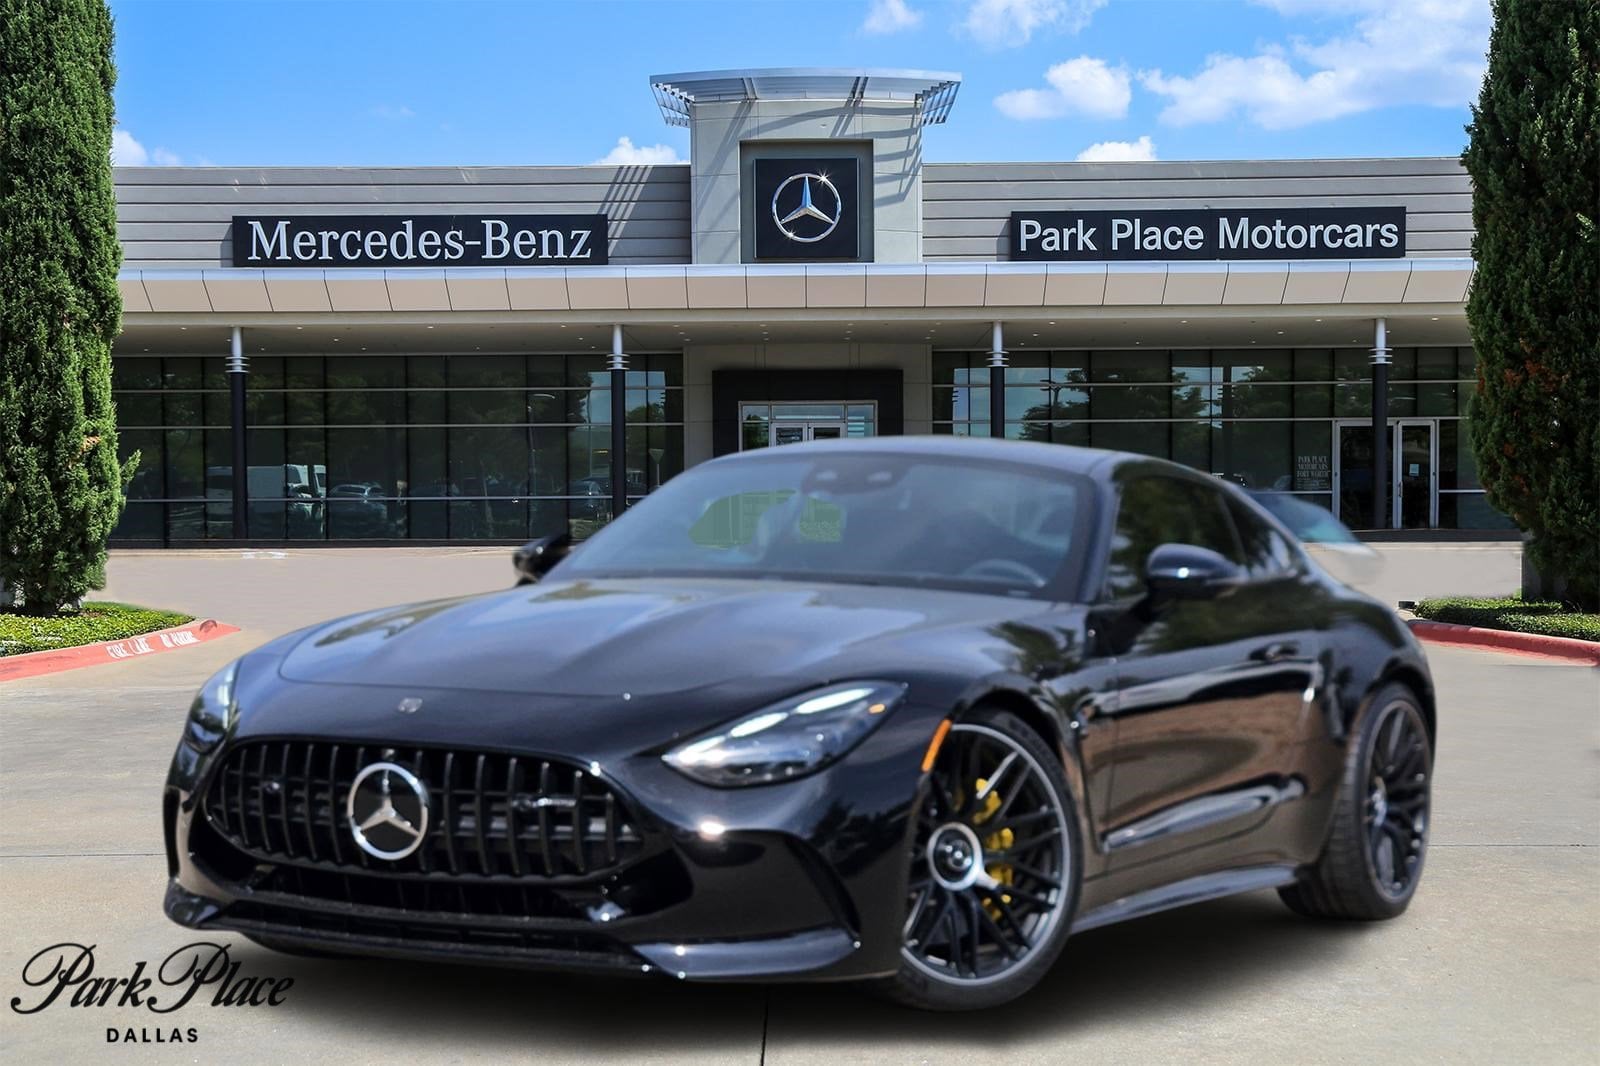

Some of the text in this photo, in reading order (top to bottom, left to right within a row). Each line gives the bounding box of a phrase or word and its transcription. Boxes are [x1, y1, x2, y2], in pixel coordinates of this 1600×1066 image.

[247, 219, 592, 260] Mercedes-Benz
[1019, 217, 1399, 252] Park Place Motorcars
